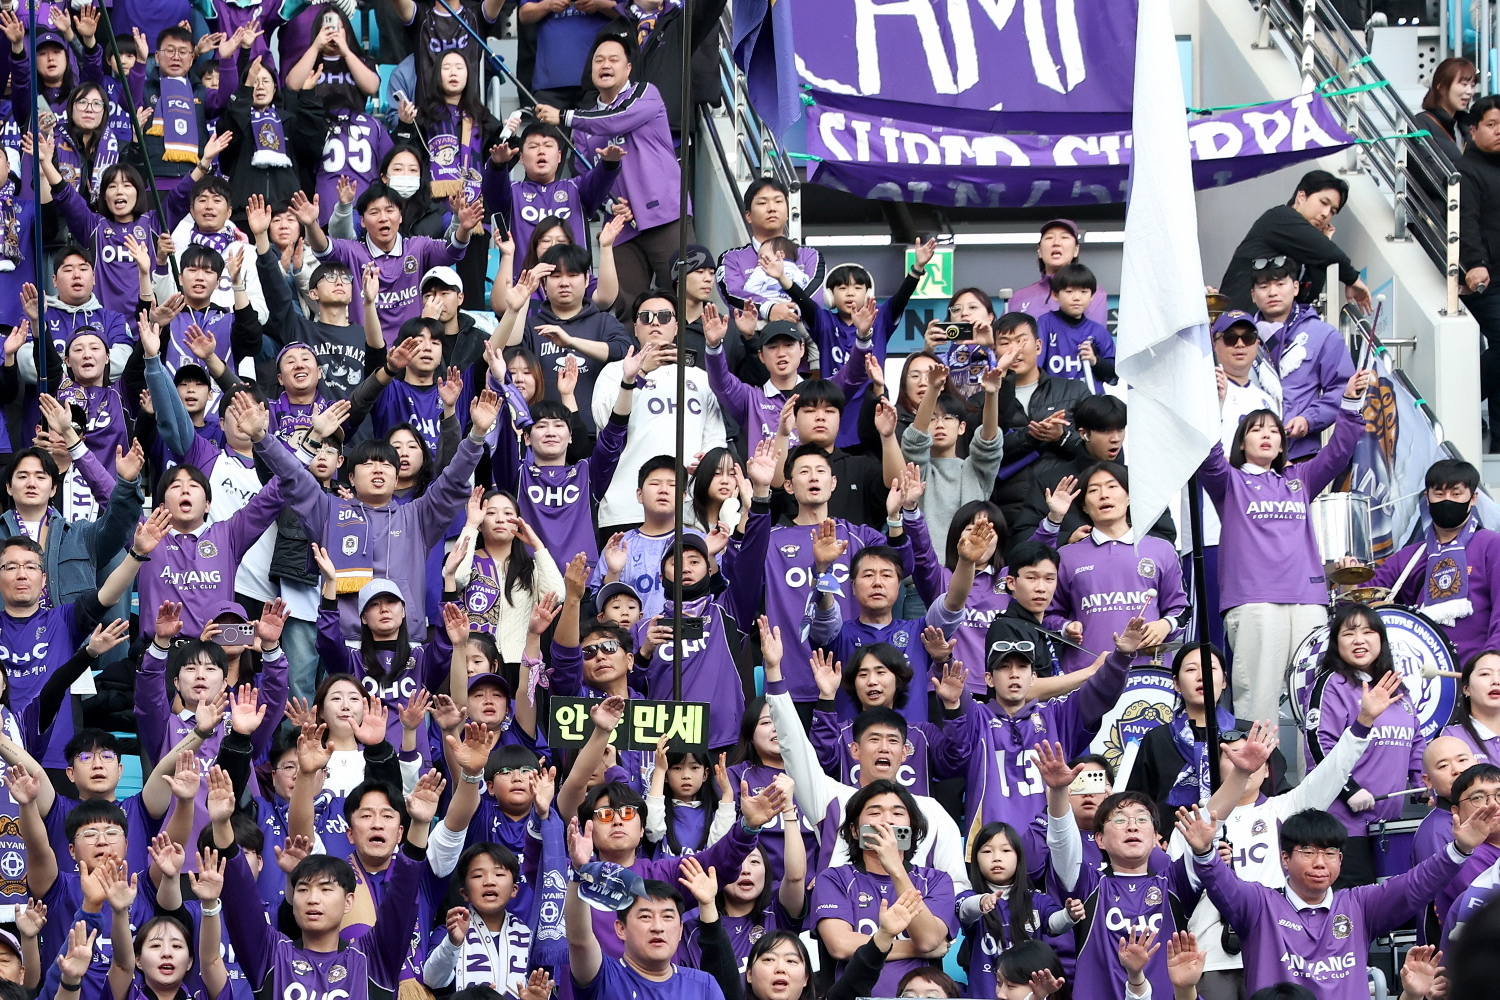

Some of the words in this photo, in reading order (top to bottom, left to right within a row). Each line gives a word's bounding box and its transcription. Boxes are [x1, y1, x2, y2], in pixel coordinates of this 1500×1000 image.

[168, 99, 190, 110] FCA
[322, 124, 372, 173] 55
[101, 244, 132, 263] OH
[647, 398, 702, 415] OHC
[282, 416, 312, 428] ANYAN
[528, 486, 580, 506] OHC
[1246, 500, 1305, 514] ANYAN
[786, 564, 850, 587] OC
[1368, 726, 1414, 740] ANYAN
[1232, 843, 1268, 863] HC
[1278, 919, 1303, 931] BDNS
